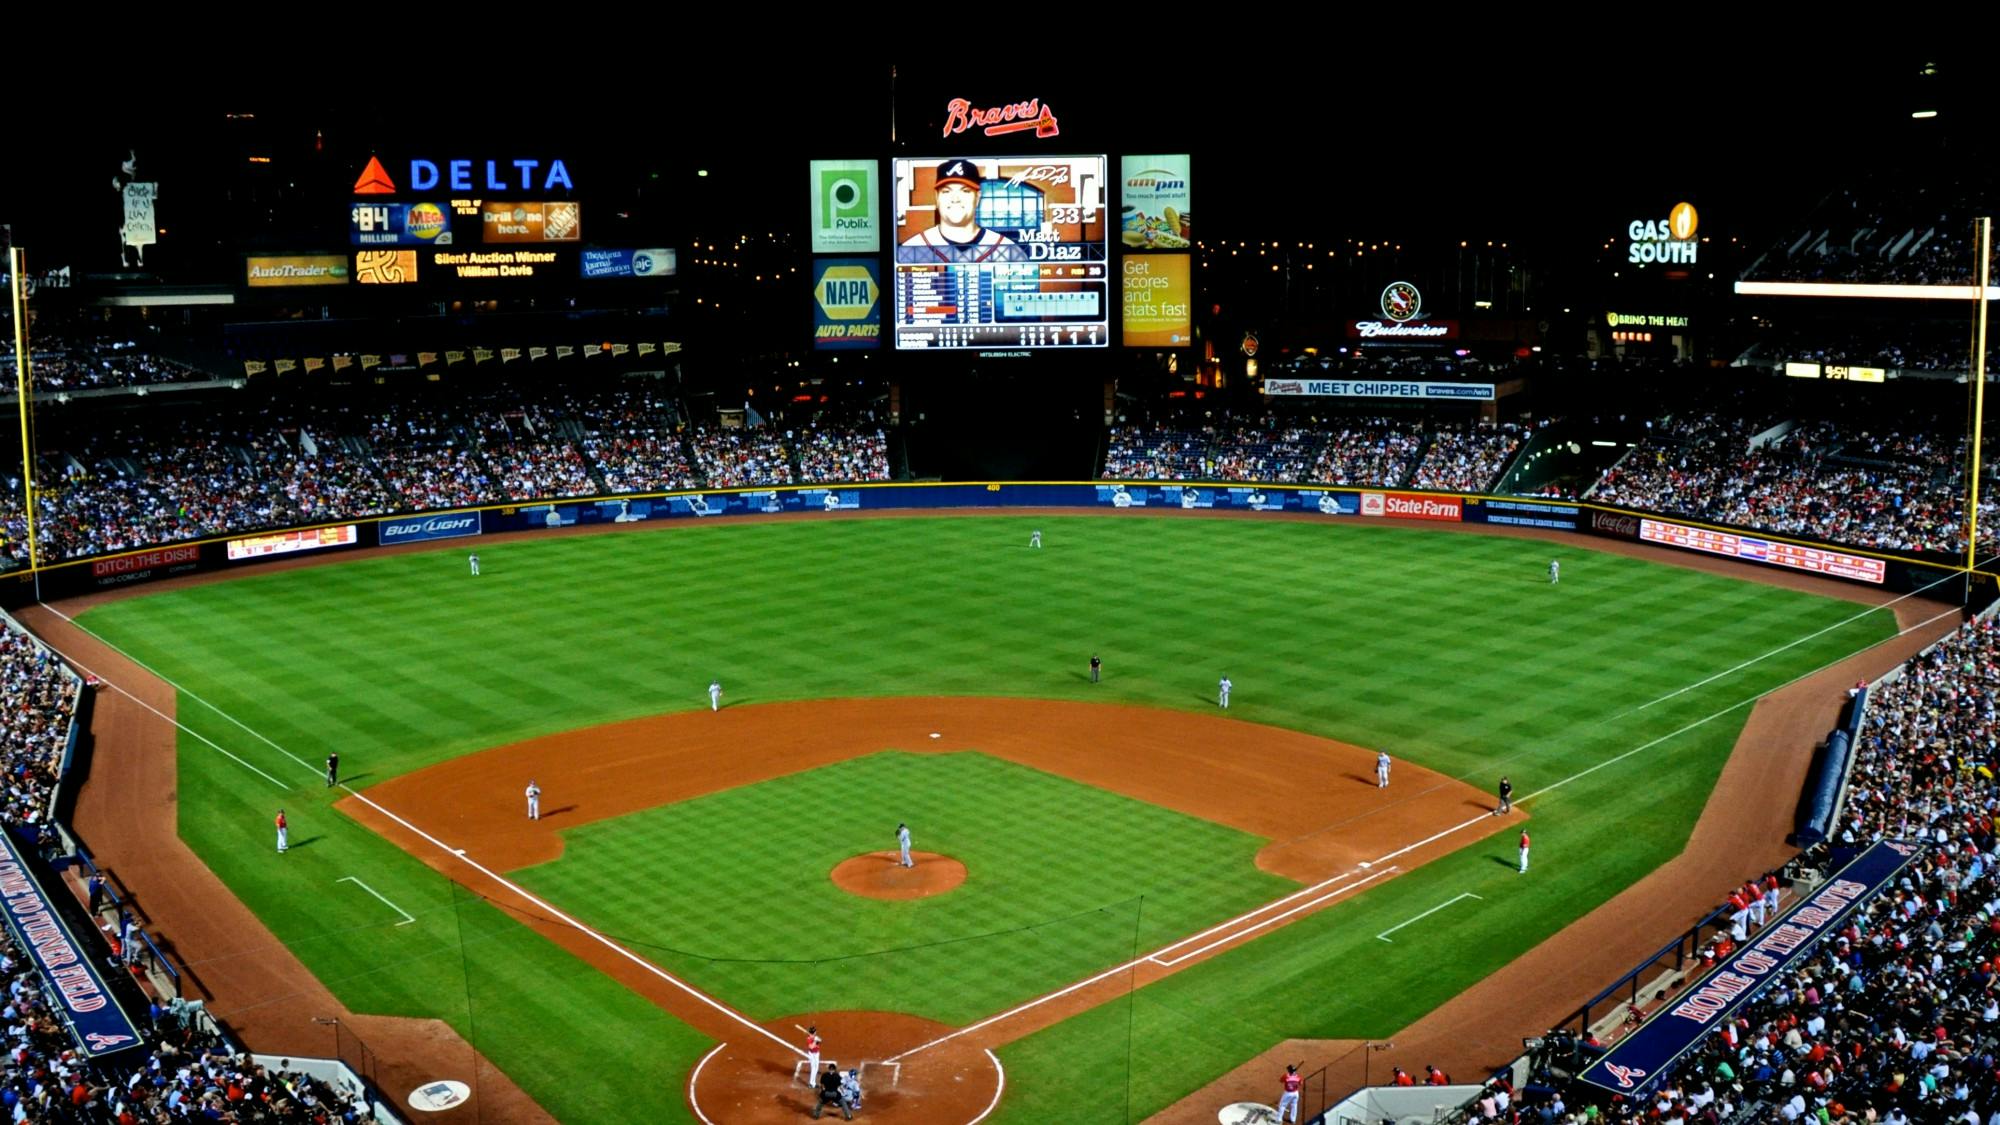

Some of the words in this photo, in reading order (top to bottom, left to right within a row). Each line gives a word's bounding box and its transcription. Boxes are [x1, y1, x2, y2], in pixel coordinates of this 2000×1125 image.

[943, 98, 1038, 138] Braves
[411, 159, 572, 190] DELTA
[1128, 179, 1185, 192] ampm
[352, 206, 388, 231] $84
[407, 210, 446, 225] MEGA
[484, 211, 511, 223] Drill
[1052, 208, 1079, 224] 23
[498, 223, 530, 234] here.
[836, 218, 868, 229] Publix
[1629, 220, 1670, 241] GAS
[360, 234, 398, 244] MILLION
[1018, 229, 1060, 242] Matt
[435, 253, 466, 264] Silent
[468, 252, 515, 263] Auction
[518, 251, 556, 262] Winner
[1030, 243, 1081, 260] Diaz
[1628, 242, 1697, 263] SOUTH
[251, 265, 327, 277] AutoTrader
[457, 265, 499, 277] William
[502, 264, 533, 276] Davis
[635, 258, 651, 270] ajc
[1124, 260, 1149, 274] Get
[1124, 277, 1168, 288] scores
[826, 281, 869, 305] NAPA
[1124, 288, 1151, 302] and
[1124, 304, 1157, 316] stats
[1162, 302, 1187, 316] fast
[1618, 314, 1646, 325] BRING
[1648, 315, 1664, 326] THE
[1666, 316, 1688, 326] HEAT
[816, 324, 846, 338] AUTO
[847, 324, 880, 337] PARTS
[1356, 322, 1448, 337] Budweiser
[1052, 332, 1058, 344] 1
[1070, 332, 1077, 344] 1
[1089, 332, 1096, 344] 1
[1825, 365, 1848, 379] 9:54
[1308, 382, 1350, 394] MEET
[1354, 383, 1419, 396] CHIPPER
[1428, 387, 1490, 396] braves.com/win
[385, 524, 421, 536] BUD
[428, 518, 475, 531] LIGHT
[96, 558, 134, 574] DITCH
[137, 553, 161, 565] THE
[164, 548, 196, 562] DISH!
[98, 570, 151, 584] 1-800-COMCAST
[8, 892, 44, 914] TO
[1791, 879, 1868, 929] BRAVES
[18, 910, 78, 970] TURNER
[1755, 924, 1814, 956] THE
[1734, 954, 1779, 976] OF
[49, 963, 107, 1013] FIELD
[1670, 970, 1755, 1024] HOME
